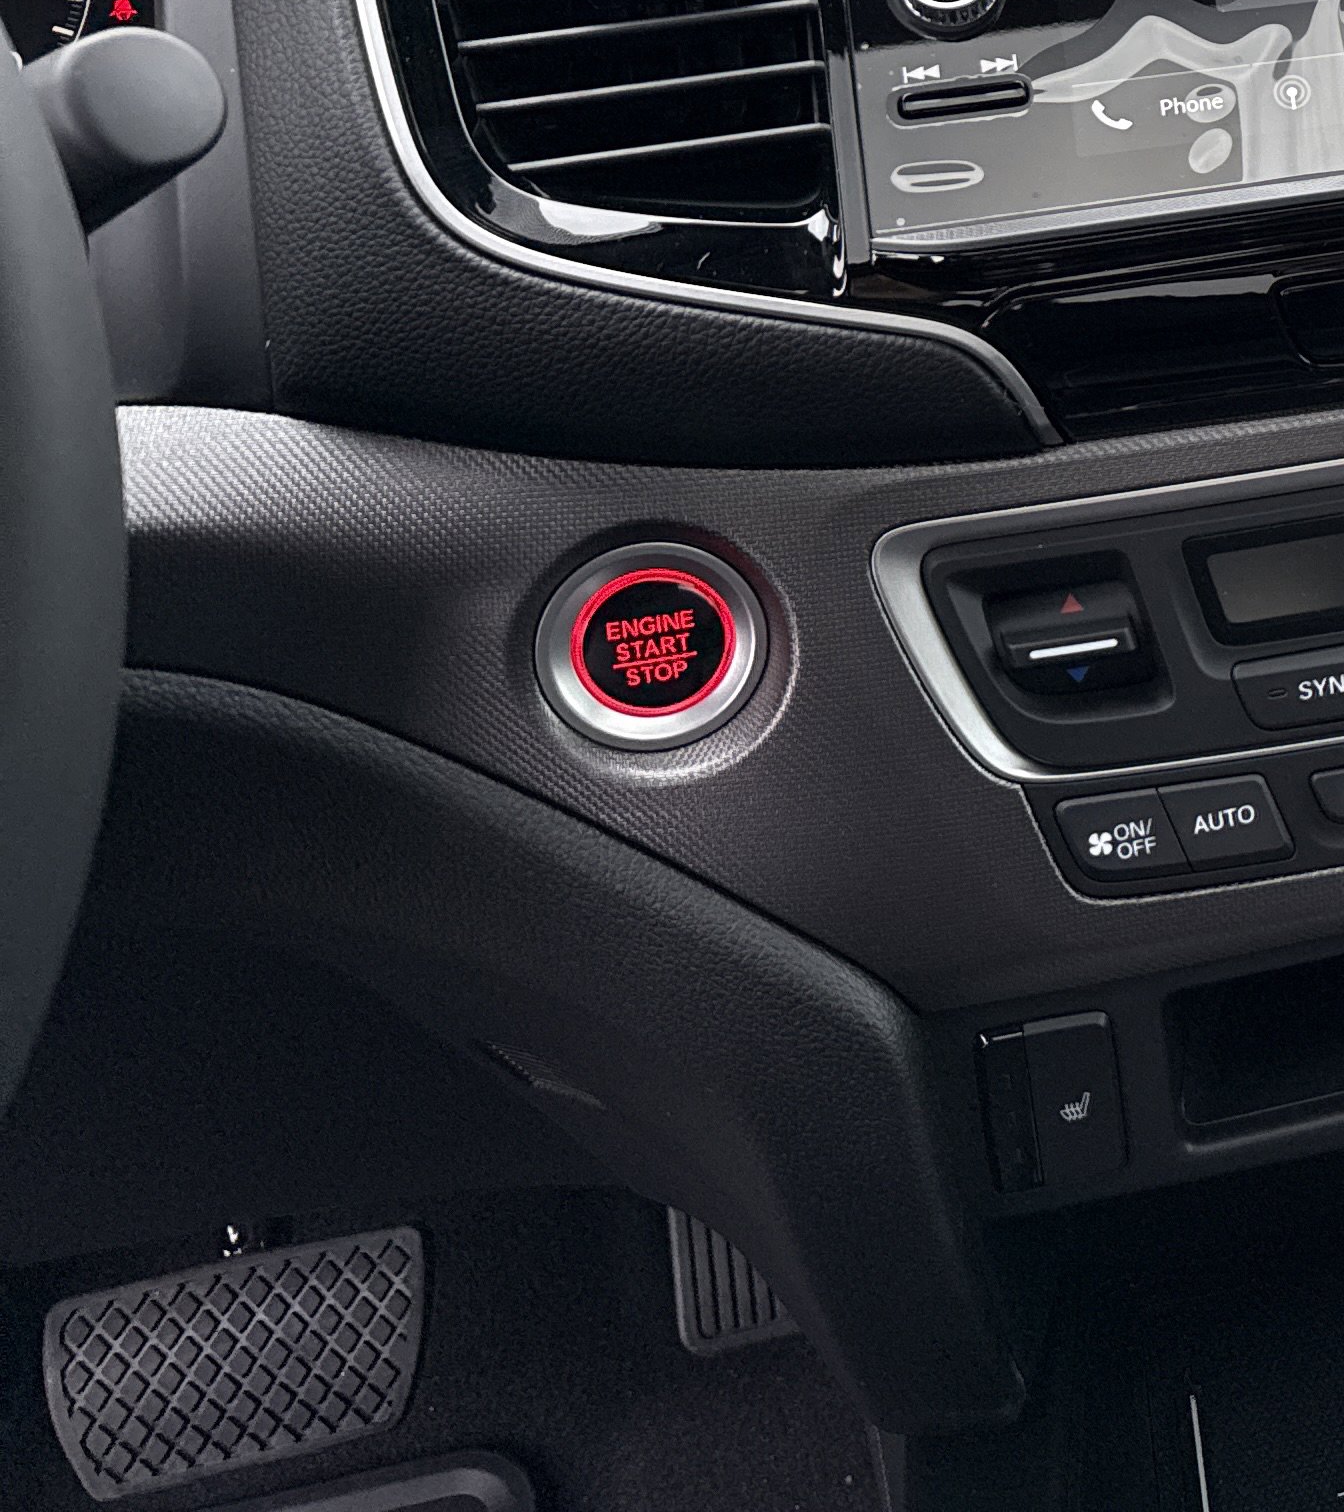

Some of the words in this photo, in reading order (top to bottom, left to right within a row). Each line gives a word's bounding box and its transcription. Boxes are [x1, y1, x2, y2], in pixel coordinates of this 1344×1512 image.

[1159, 92, 1224, 117] Phone
[605, 609, 696, 641] ENGINE
[615, 632, 690, 662] START
[626, 661, 689, 687] STOP
[1193, 804, 1256, 835] AUTO
[1116, 837, 1157, 861] OFF
